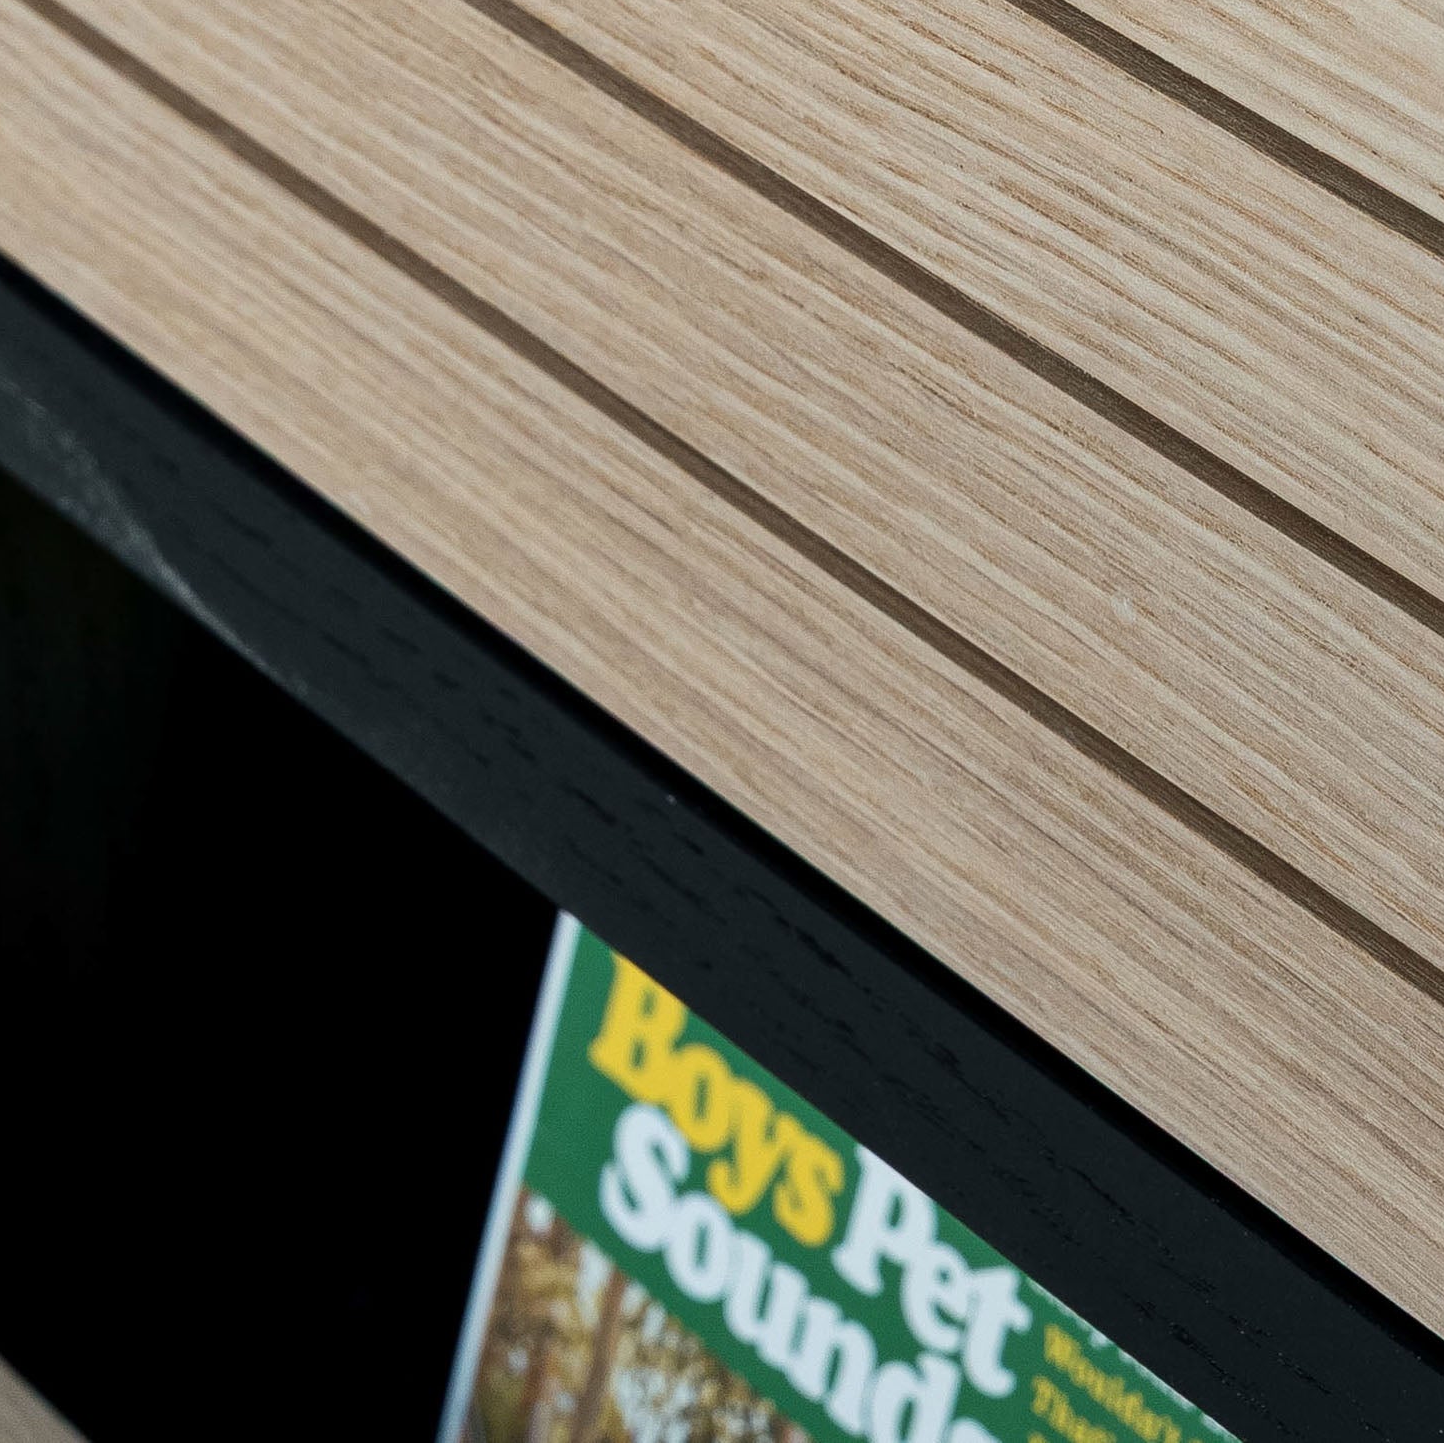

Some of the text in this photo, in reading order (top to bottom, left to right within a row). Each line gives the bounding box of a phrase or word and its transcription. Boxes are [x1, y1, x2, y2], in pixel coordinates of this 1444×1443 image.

[587, 951, 1033, 1397] Boys Pet
[598, 1103, 1002, 1443] Sound
